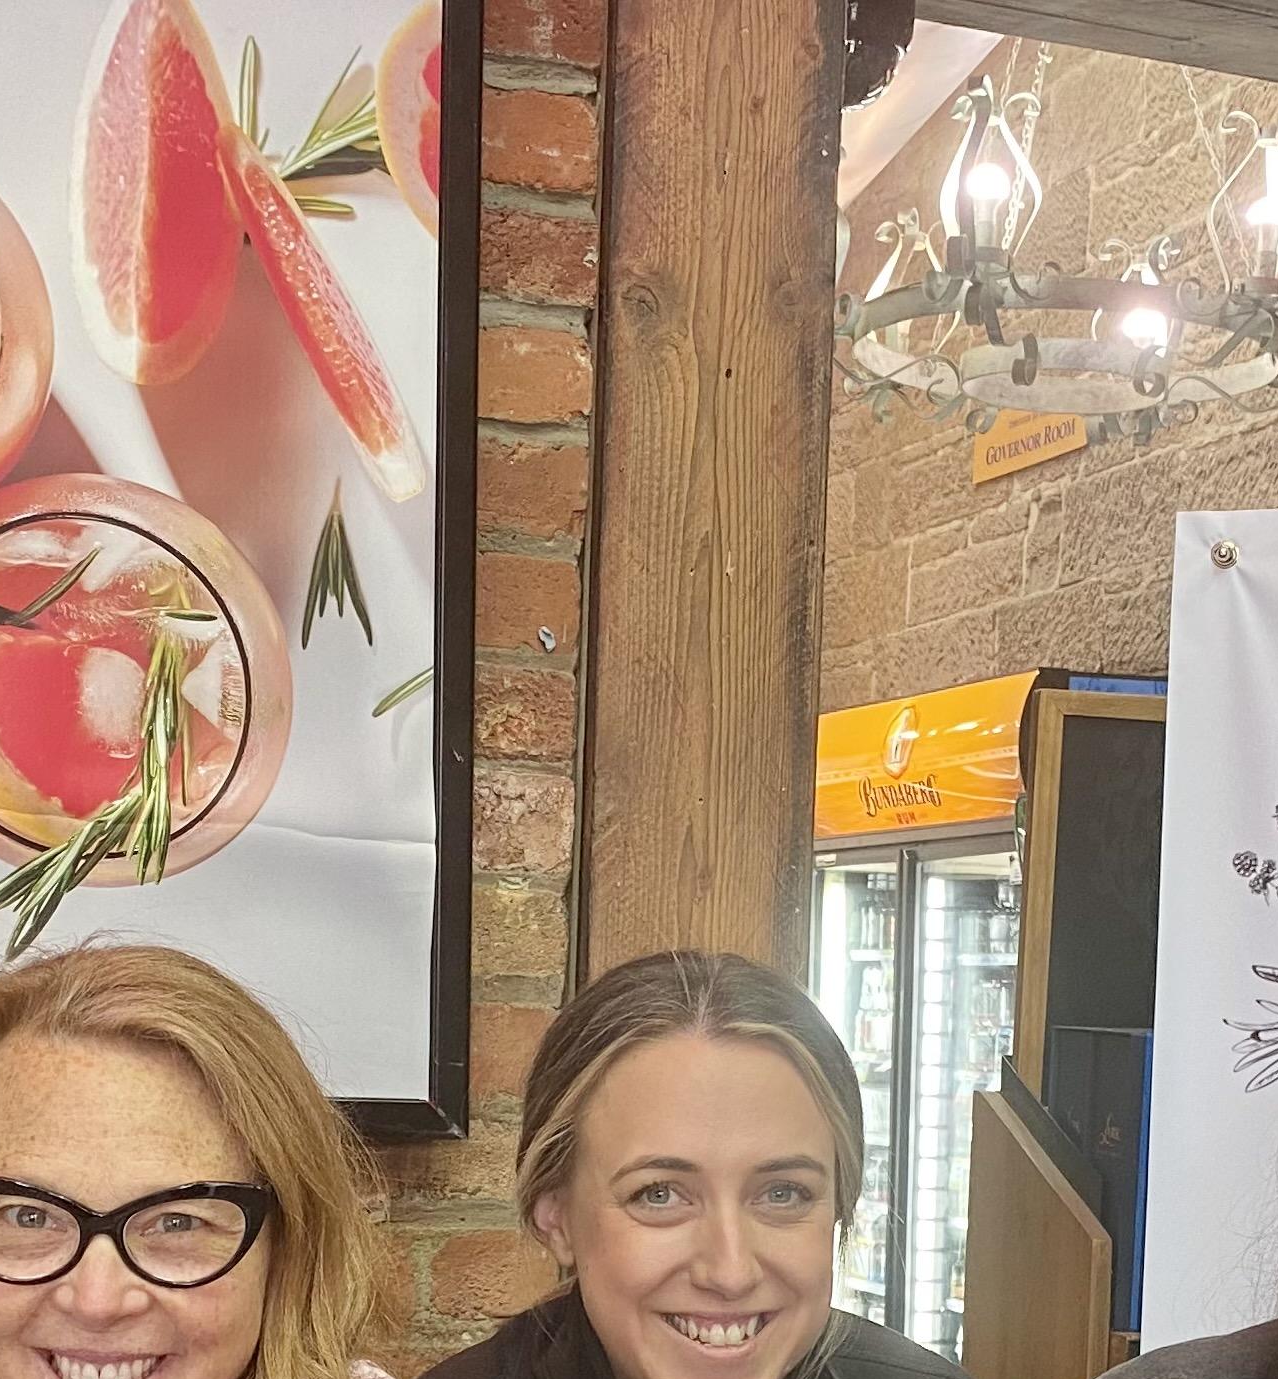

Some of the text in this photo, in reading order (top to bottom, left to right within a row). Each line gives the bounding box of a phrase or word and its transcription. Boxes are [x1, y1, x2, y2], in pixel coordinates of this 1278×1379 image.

[986, 432, 1042, 465] GOVERNOR
[1044, 419, 1076, 444] ROOM
[859, 773, 941, 817] BUNDABERG
